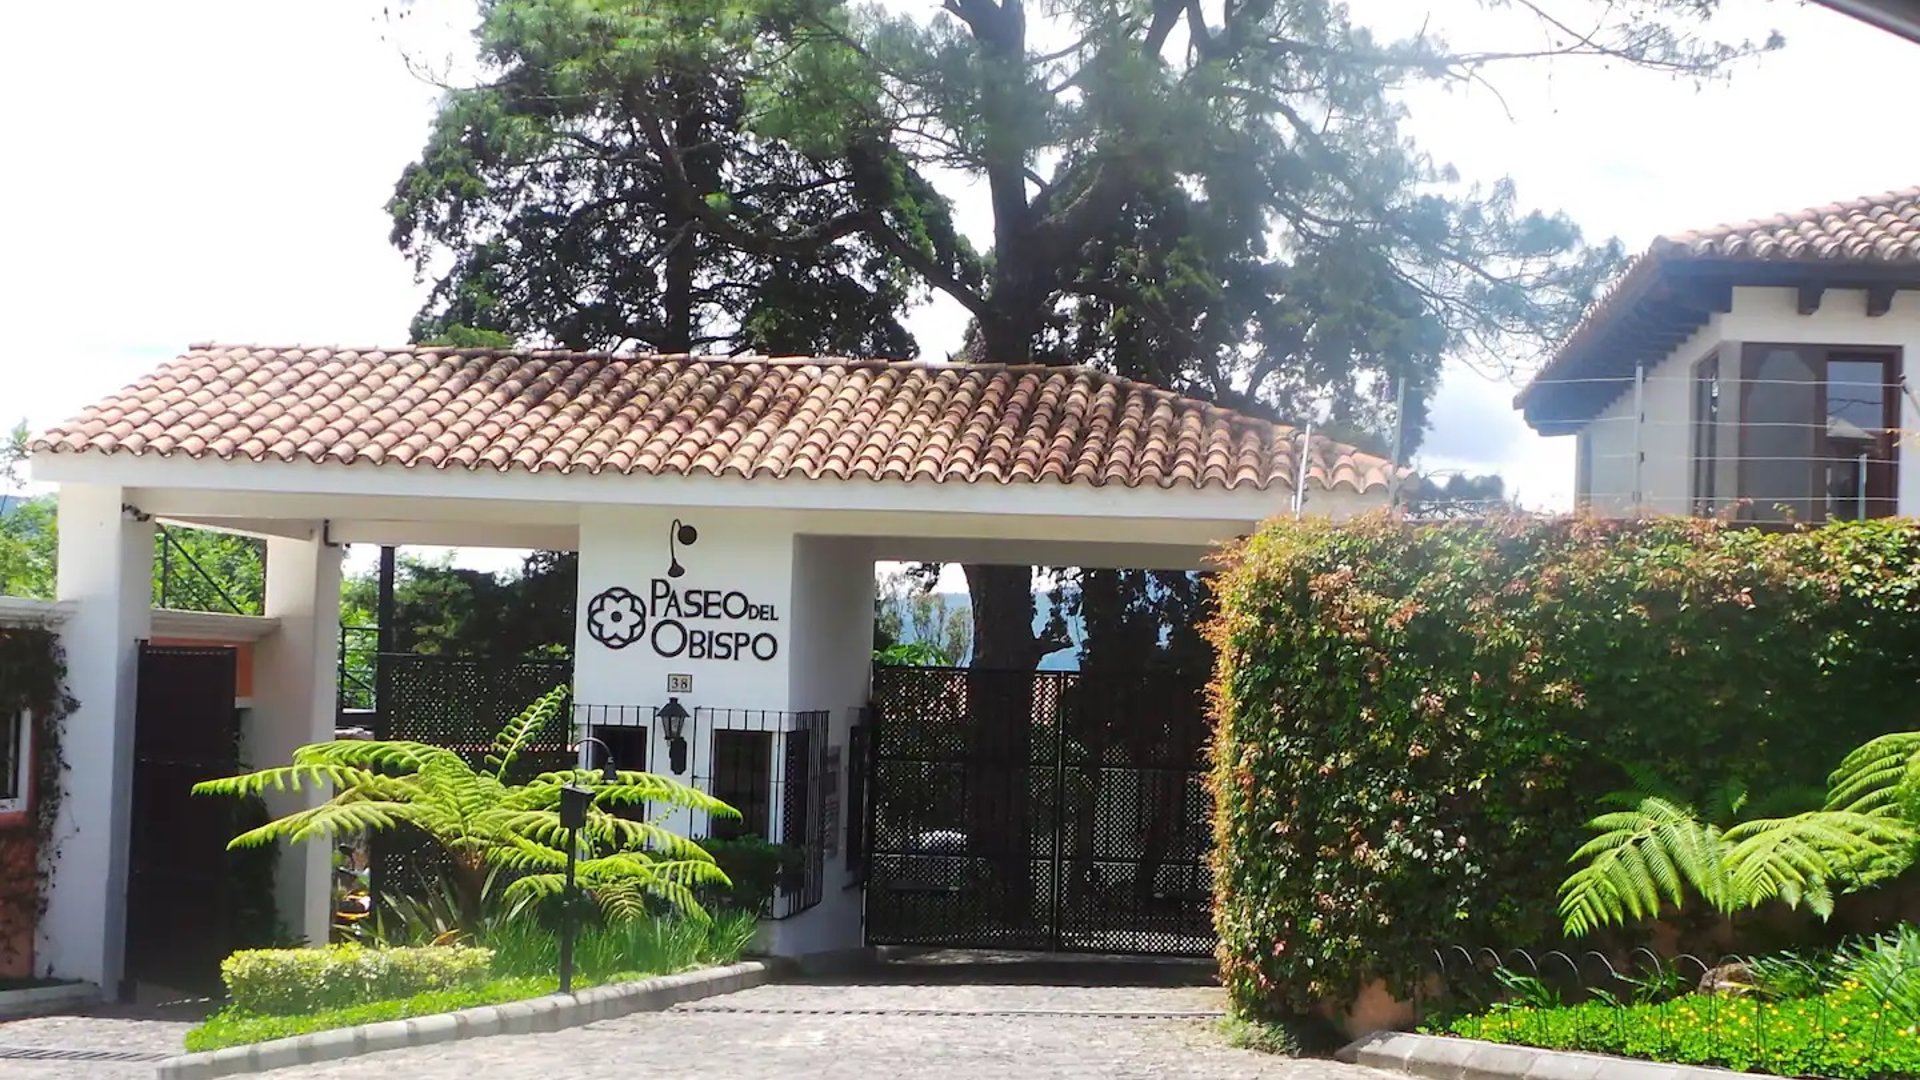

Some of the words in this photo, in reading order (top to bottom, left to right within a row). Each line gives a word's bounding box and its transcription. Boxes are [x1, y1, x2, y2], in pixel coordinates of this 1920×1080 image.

[650, 579, 749, 619] PASEO
[749, 604, 779, 621] DEL
[651, 619, 778, 661] OBISPO
[671, 677, 689, 690] 38
